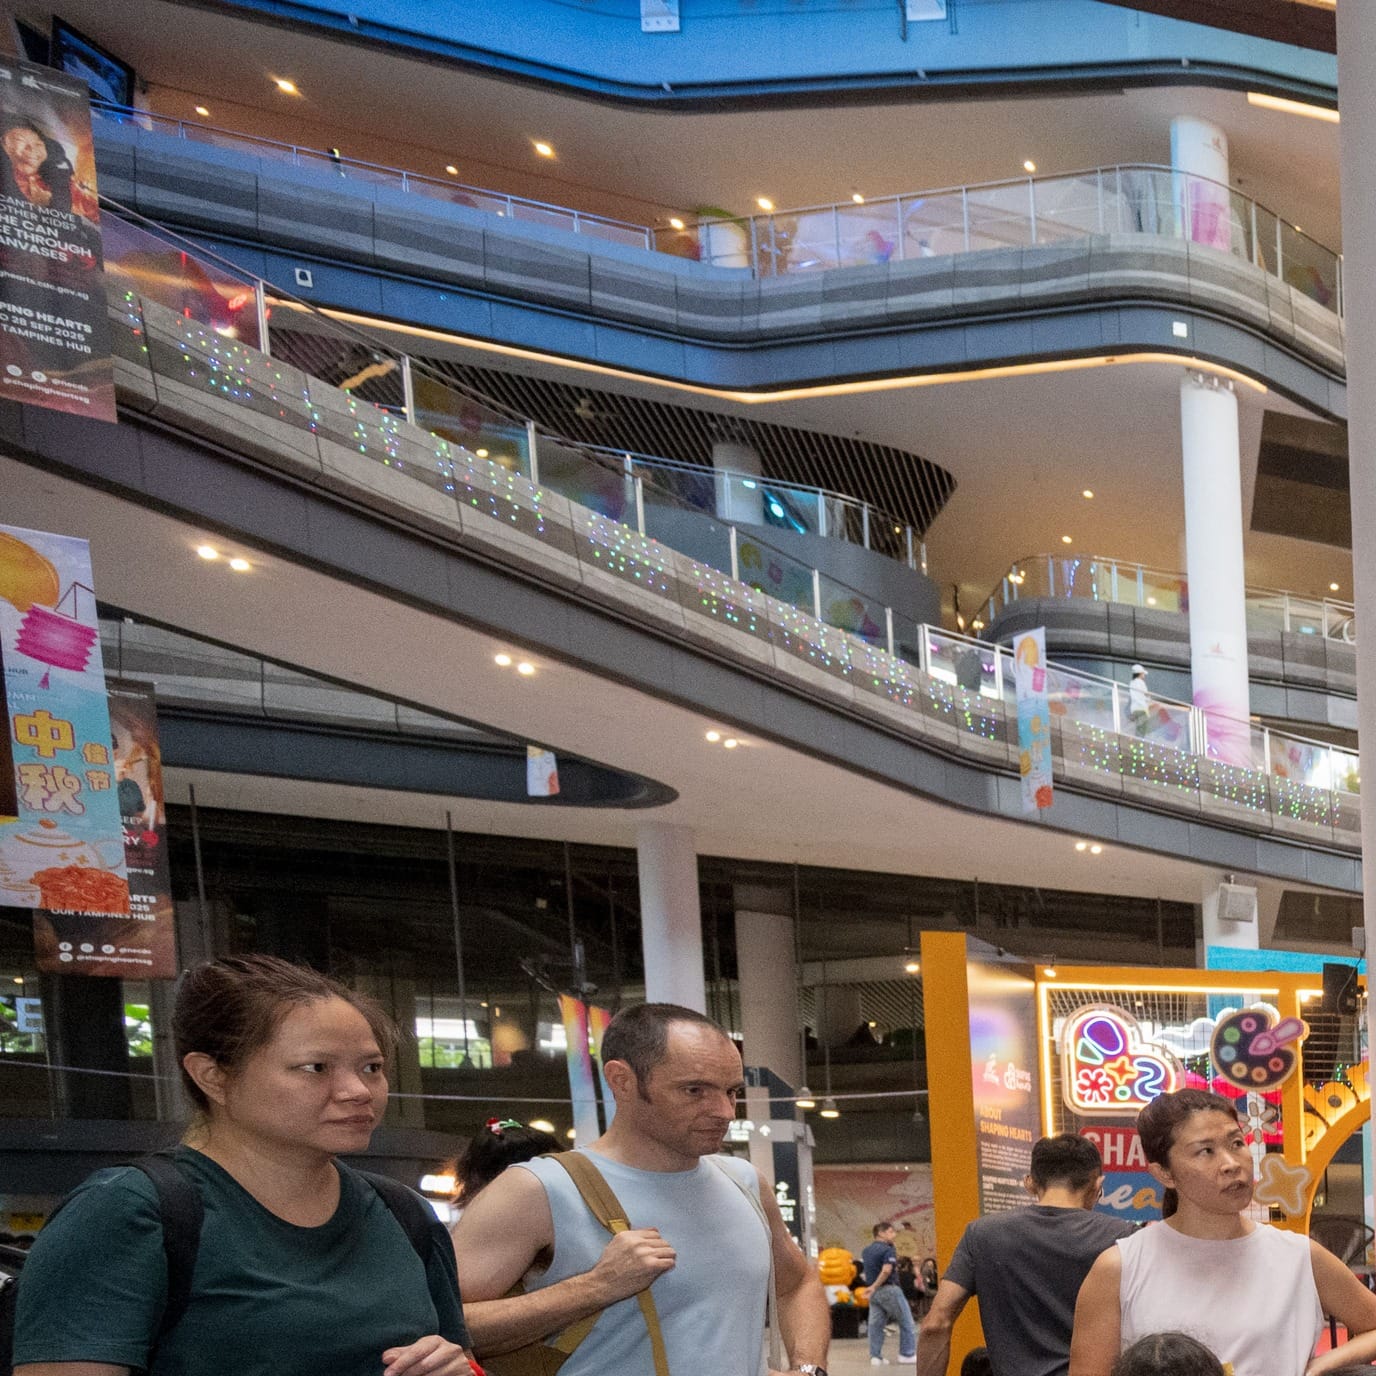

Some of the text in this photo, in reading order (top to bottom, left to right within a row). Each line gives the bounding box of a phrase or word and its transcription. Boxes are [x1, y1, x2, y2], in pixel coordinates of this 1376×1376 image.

[39, 207, 75, 222] MOVE
[22, 221, 58, 238] CAN
[13, 228, 92, 258] THROUGH
[30, 321, 52, 332] SEP
[36, 312, 92, 334] HEARTS
[2, 324, 91, 354] TAMPINES HUB
